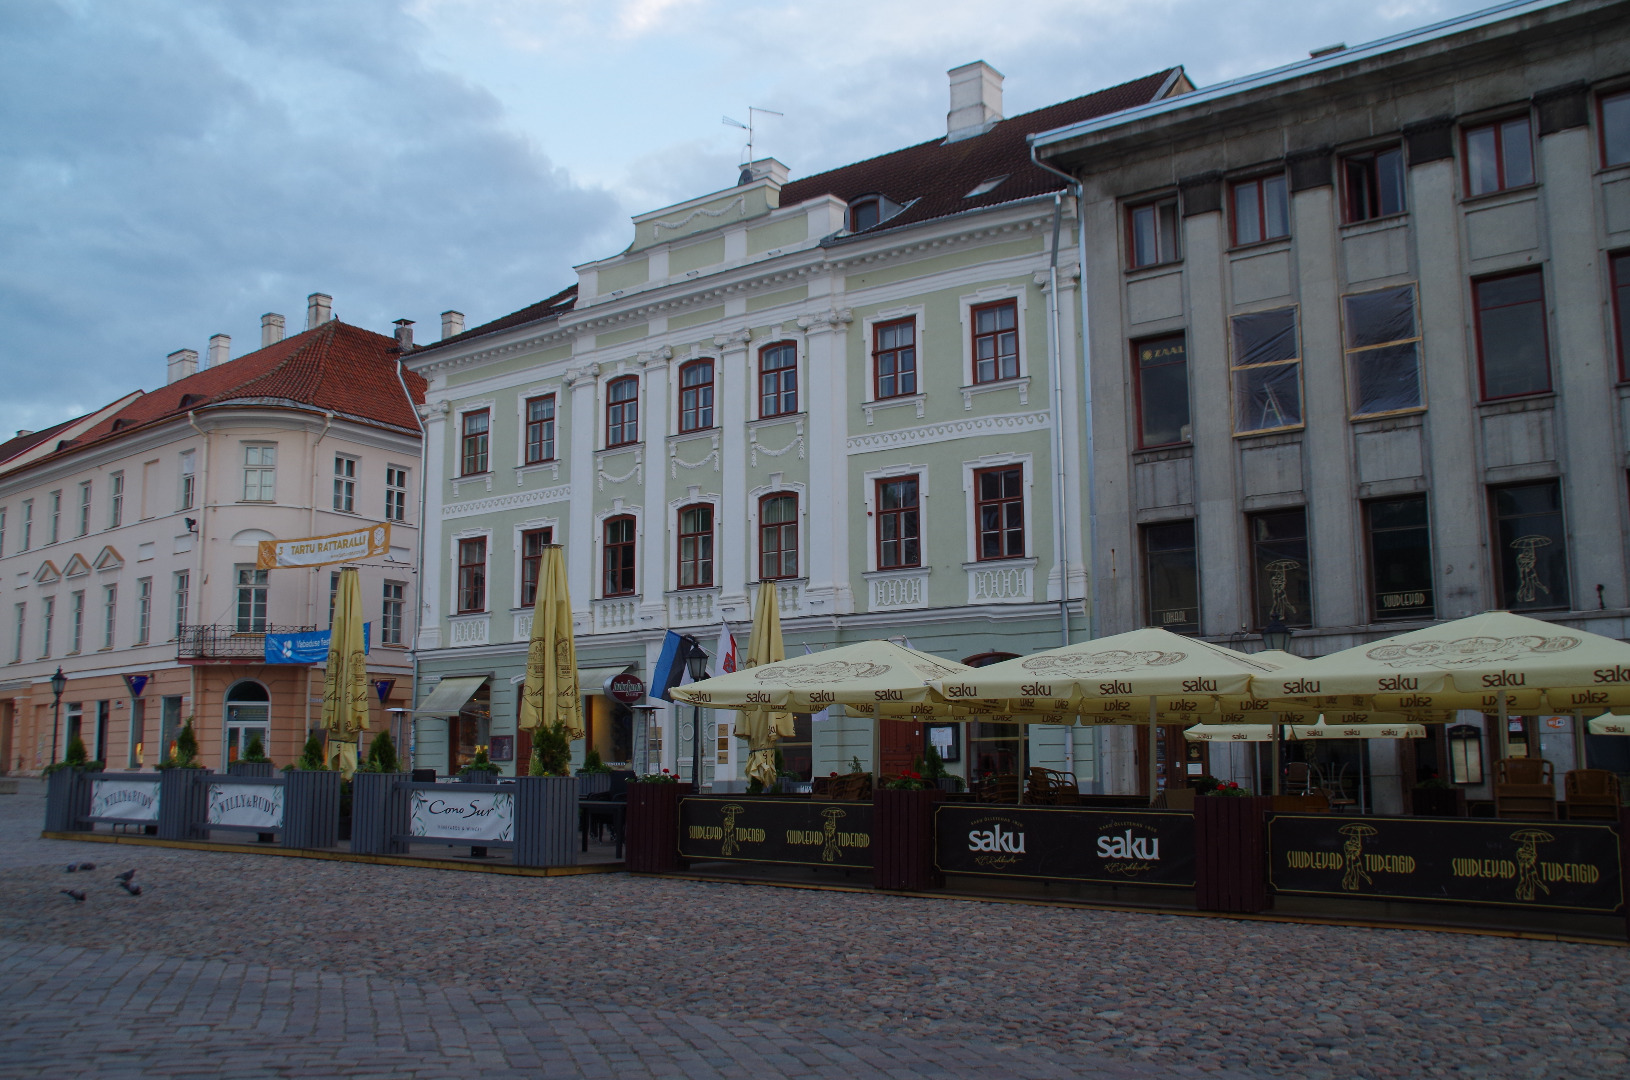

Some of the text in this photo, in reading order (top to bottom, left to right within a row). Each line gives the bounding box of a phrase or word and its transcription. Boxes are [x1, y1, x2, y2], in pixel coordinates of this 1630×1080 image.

[1154, 346, 1184, 357] ZAAL
[291, 545, 315, 555] TARTU
[318, 535, 366, 552] RATTARALLI
[1384, 592, 1425, 608] SUUDLEVAD
[1182, 676, 1218, 692] saku
[1283, 678, 1320, 694] saku
[1378, 674, 1418, 690] saku
[1482, 670, 1525, 688] saku
[874, 688, 904, 702] saku
[948, 683, 978, 697] saku
[1021, 682, 1052, 696] saku
[1100, 680, 1132, 695] saku
[688, 690, 712, 702] saku
[746, 690, 771, 703] saku
[809, 690, 836, 702] saku
[1344, 728, 1360, 736] saku
[1381, 728, 1398, 736] saku
[428, 800, 494, 818] Cono Sur
[688, 826, 766, 842] SUUDLEVAD TUDENGID
[786, 830, 870, 848] SUUDLEVAD TUDENGID
[968, 824, 1026, 854] saku
[1096, 828, 1160, 860] saku
[1286, 850, 1416, 874] SUUDLEVAD TUDENGID
[1451, 858, 1600, 884] SUUDLEVAD TUDENGID
